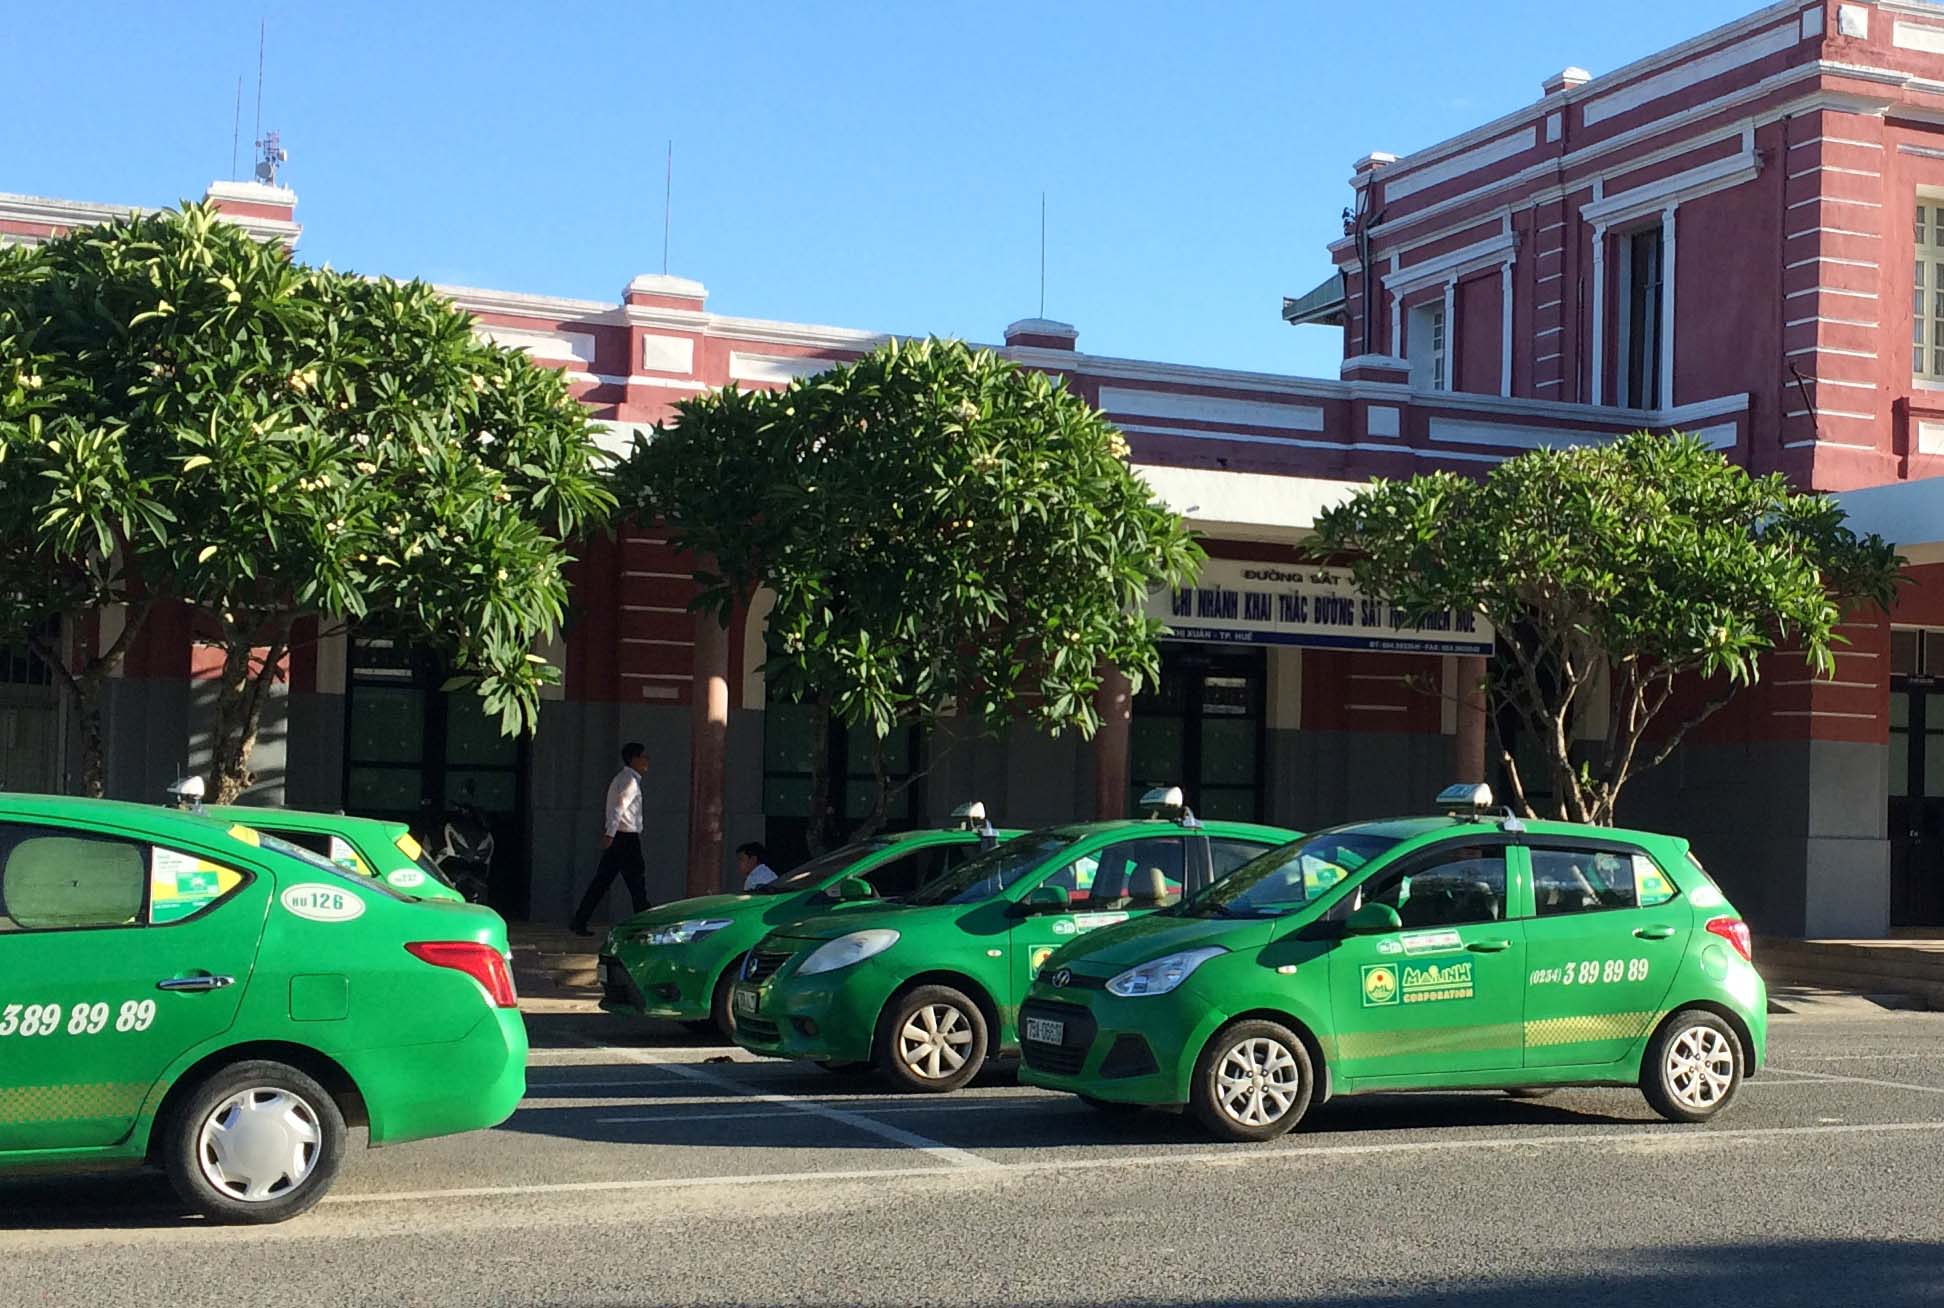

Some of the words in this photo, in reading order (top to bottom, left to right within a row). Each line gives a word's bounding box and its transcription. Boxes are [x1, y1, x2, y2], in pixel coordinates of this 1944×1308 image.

[1244, 569, 1303, 583] ĐƯỜNG
[1197, 585, 1238, 620] NHÁNH
[1244, 592, 1272, 621] KHAI
[1278, 589, 1309, 624] THÁC
[1314, 592, 1354, 627] ĐƯỜNG
[292, 896, 308, 907] HU
[310, 892, 343, 910] 126
[1578, 960, 1600, 984] 89
[1603, 959, 1625, 983] 89
[1628, 958, 1649, 981] 89
[1403, 989, 1473, 1003] CORPORATION
[67, 1002, 109, 1035] 89
[116, 1000, 156, 1032] 89
